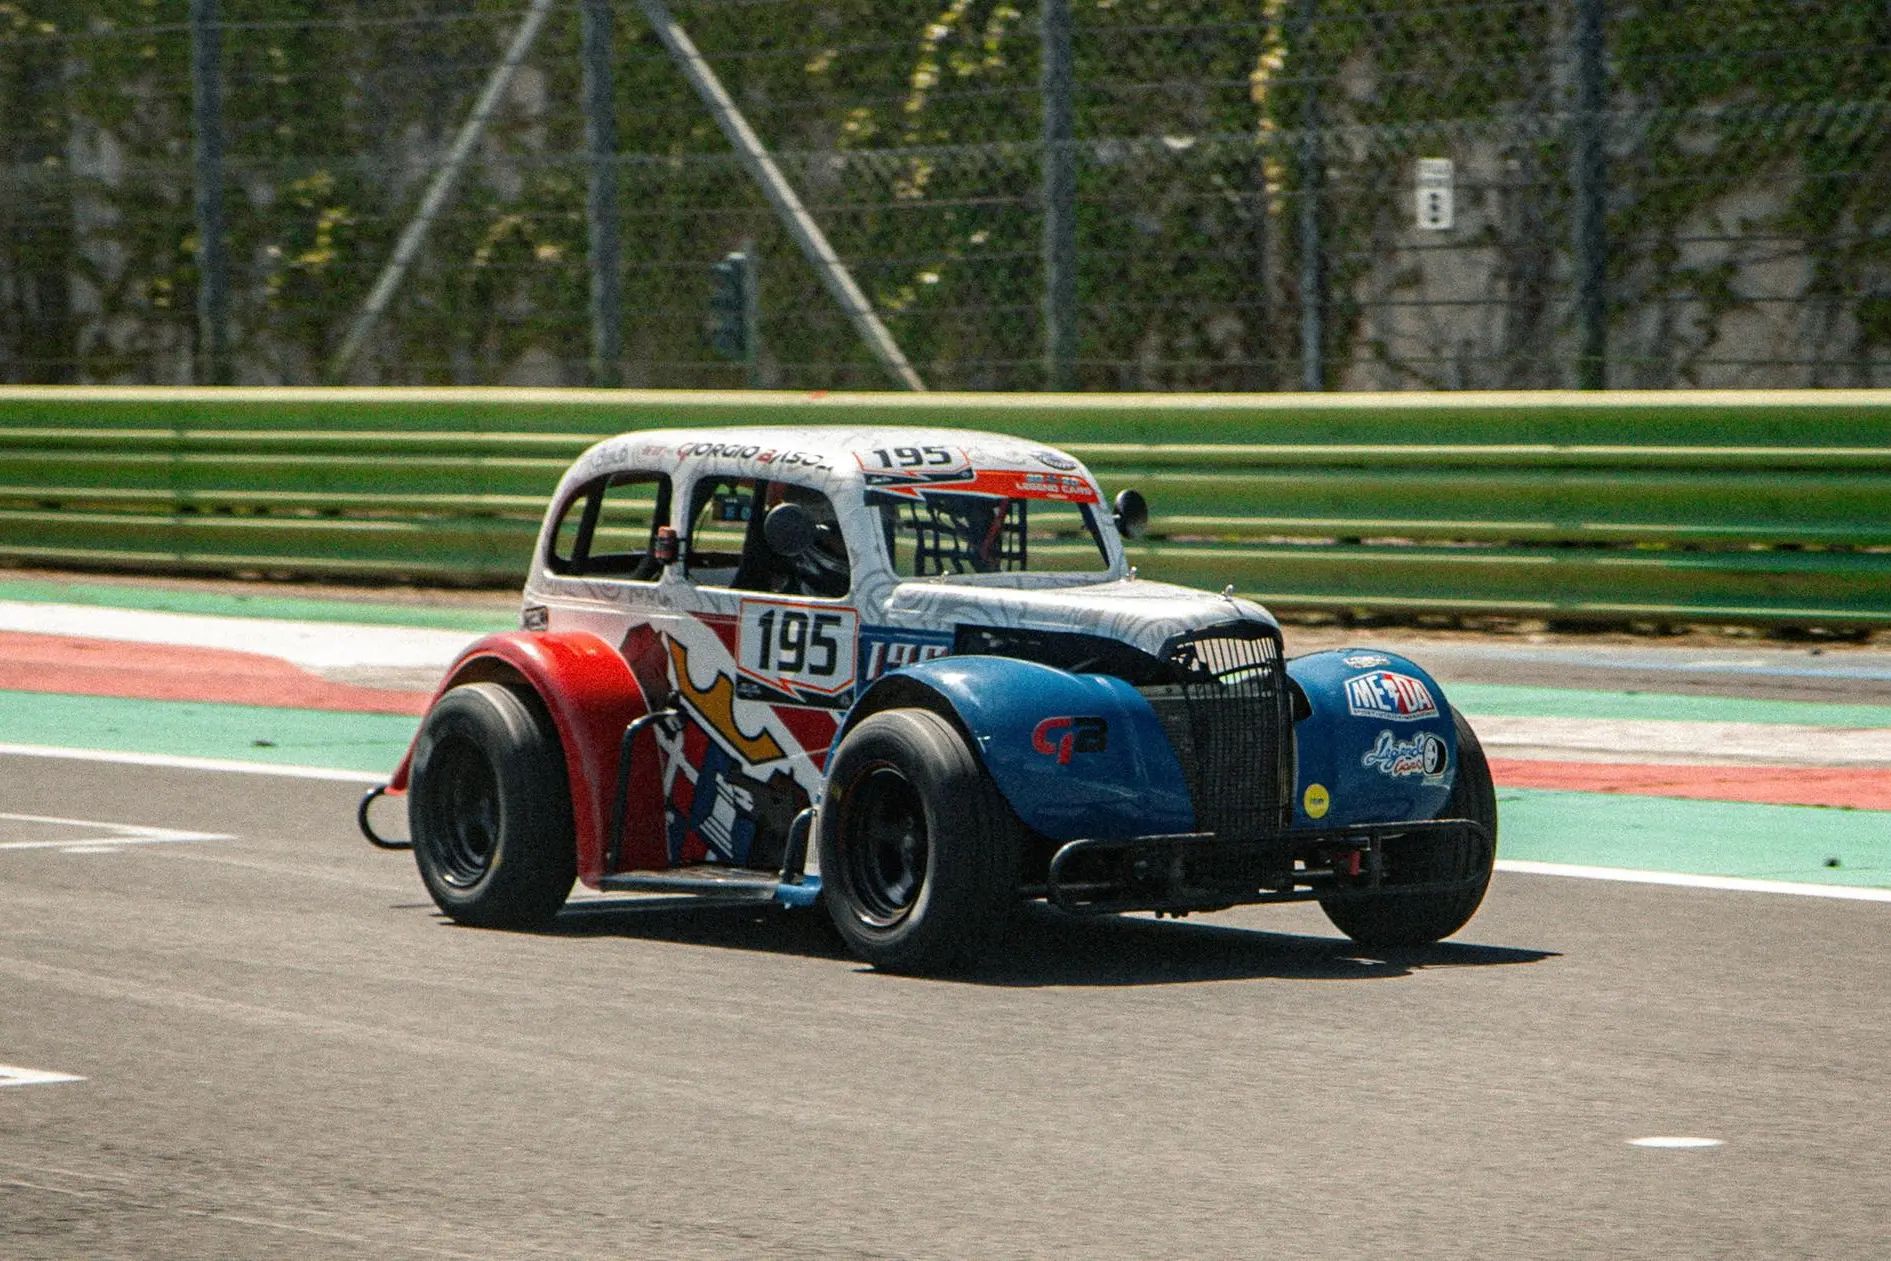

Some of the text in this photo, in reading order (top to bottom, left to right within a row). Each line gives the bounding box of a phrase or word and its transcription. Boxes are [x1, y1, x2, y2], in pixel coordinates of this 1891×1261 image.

[677, 442, 760, 463] GIORGIO
[873, 445, 952, 468] 195
[757, 608, 842, 677] 195
